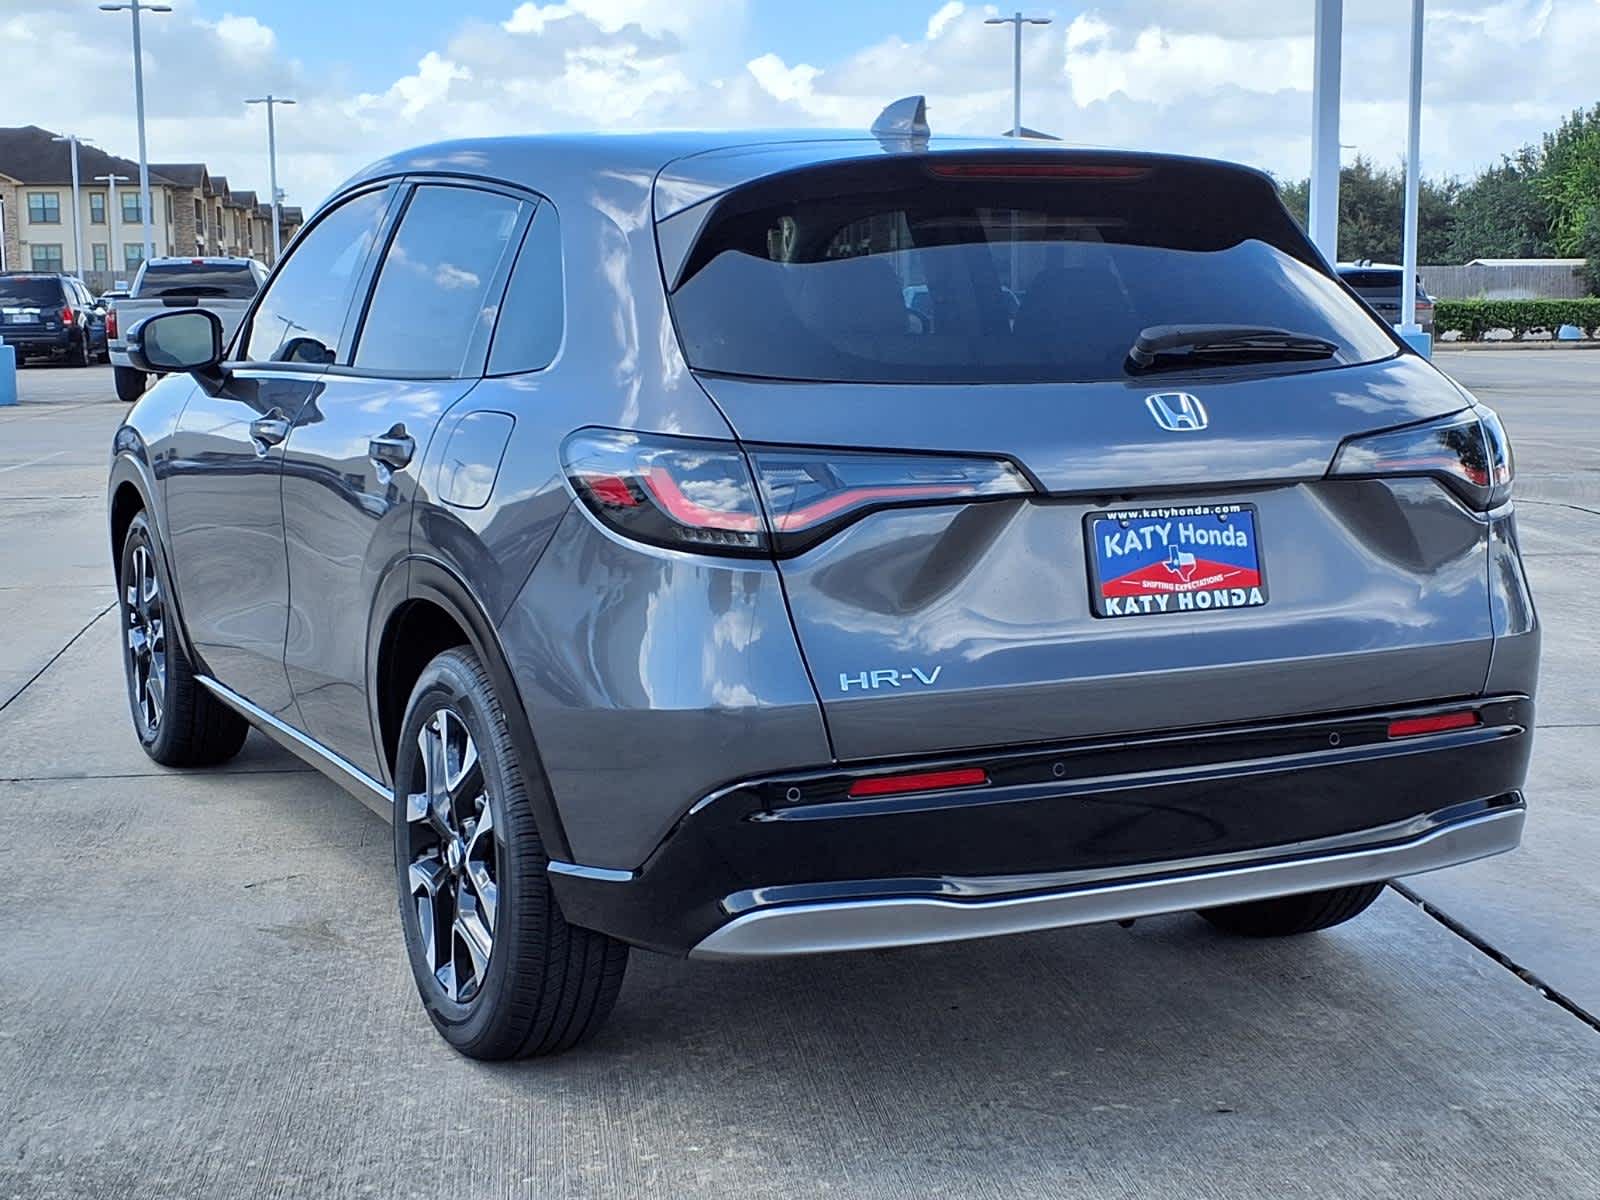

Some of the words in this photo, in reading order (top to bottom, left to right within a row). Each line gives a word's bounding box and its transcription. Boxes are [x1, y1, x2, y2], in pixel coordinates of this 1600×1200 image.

[1107, 505, 1241, 519] www.katyhonda.com
[1104, 522, 1171, 558] KATY
[1178, 522, 1248, 547] Honda
[1142, 580, 1174, 590] SHIFTING
[1174, 574, 1224, 592] EXPECTATIONS
[1105, 593, 1170, 616] KATY
[1178, 587, 1264, 611] HONDA
[839, 665, 942, 692] HR-V
